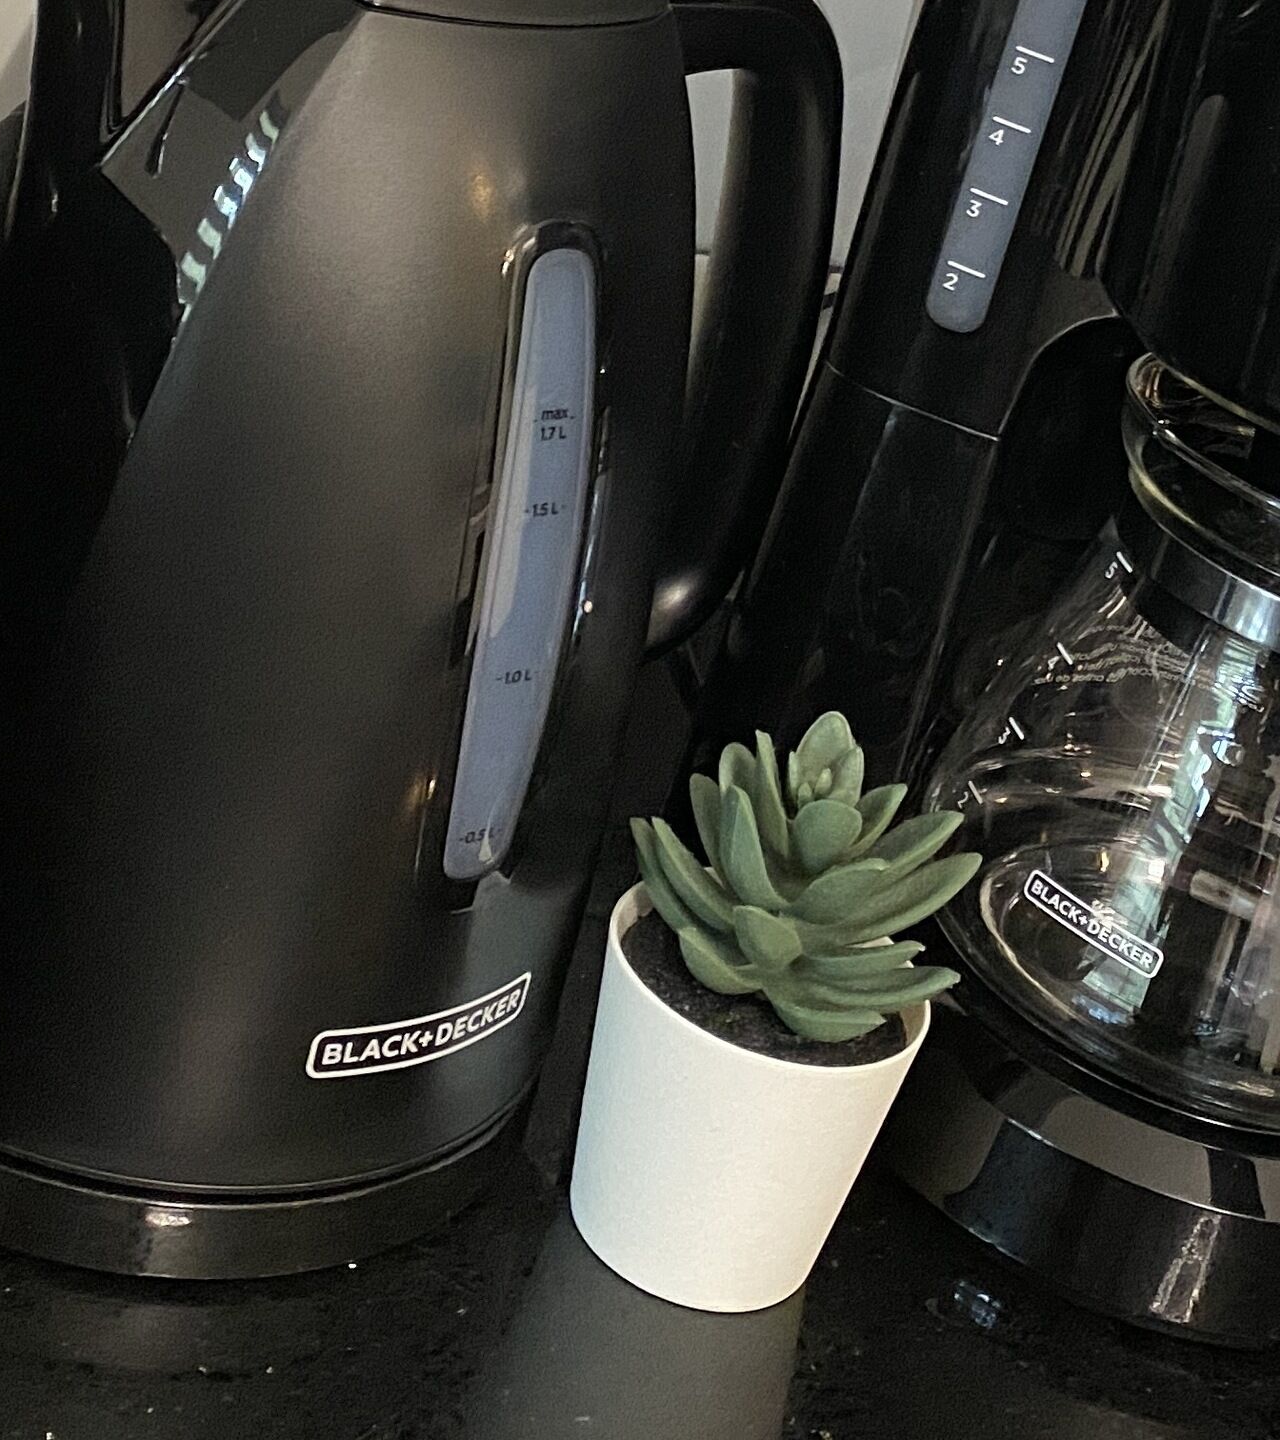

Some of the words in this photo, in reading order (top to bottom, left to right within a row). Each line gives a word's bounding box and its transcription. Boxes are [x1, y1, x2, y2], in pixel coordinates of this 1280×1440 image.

[1011, 57, 1028, 75] 5
[989, 129, 1004, 146] 4
[966, 201, 982, 218] 3
[942, 273, 959, 291] 2
[541, 409, 568, 420] max
[1104, 561, 1118, 579] 5
[998, 726, 1011, 745] 3
[957, 791, 969, 809] 2
[1030, 878, 1154, 970] BLACK+DECKER
[321, 988, 521, 1065] BLACK+DECKER
